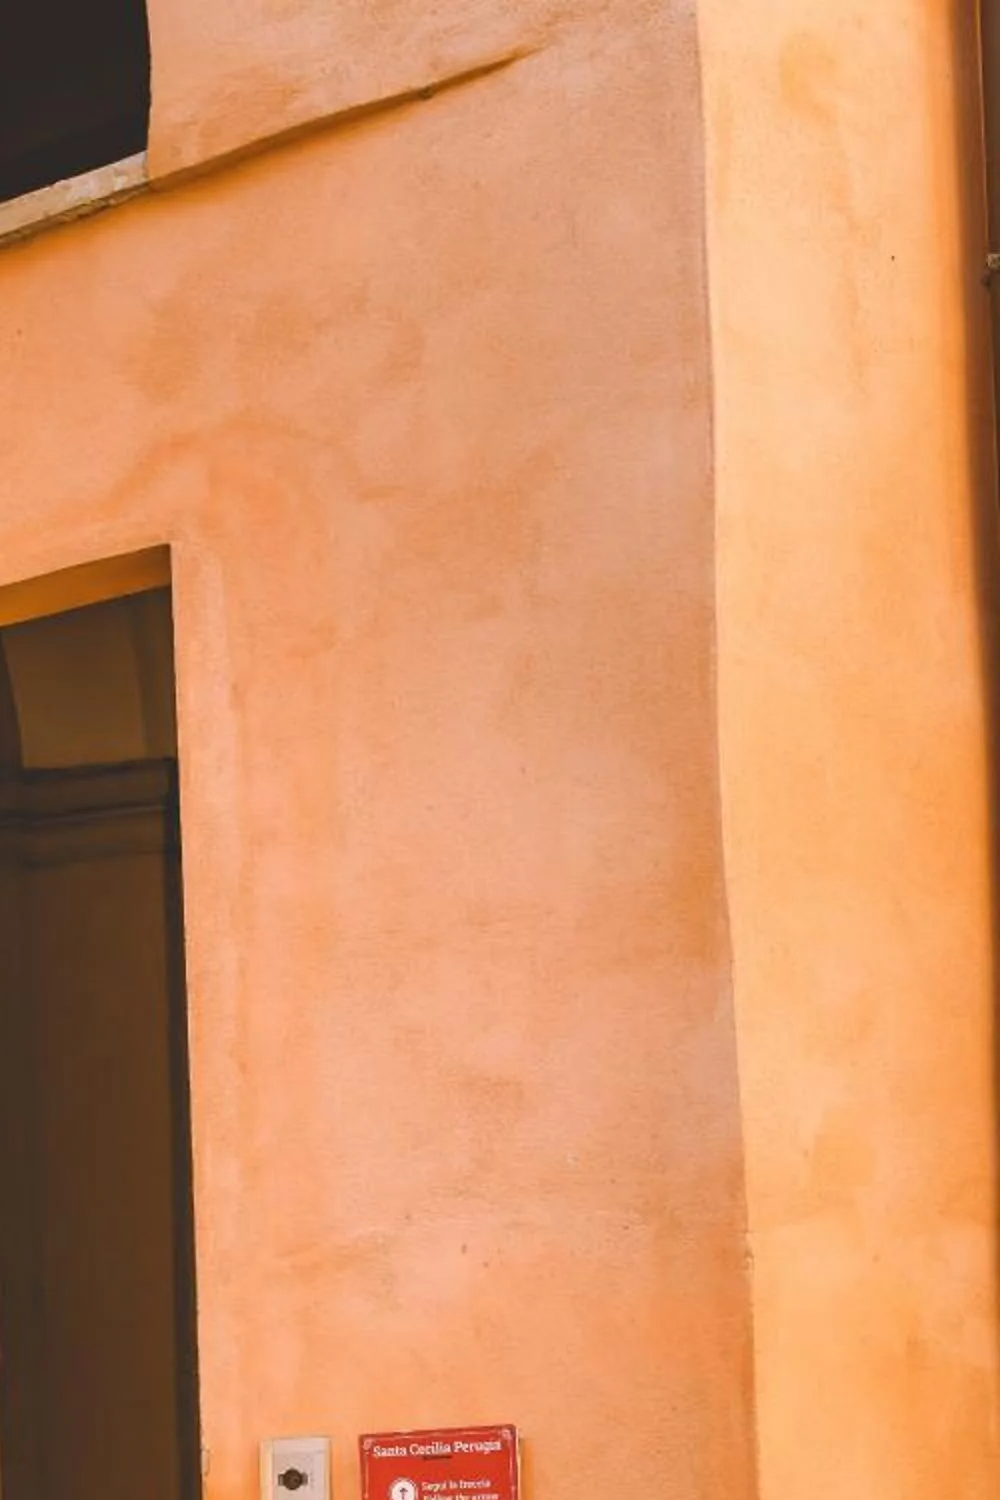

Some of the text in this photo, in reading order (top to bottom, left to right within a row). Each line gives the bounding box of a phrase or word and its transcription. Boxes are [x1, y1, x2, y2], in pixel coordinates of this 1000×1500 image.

[373, 1440, 501, 1457] Santa Cecilia Perugia
